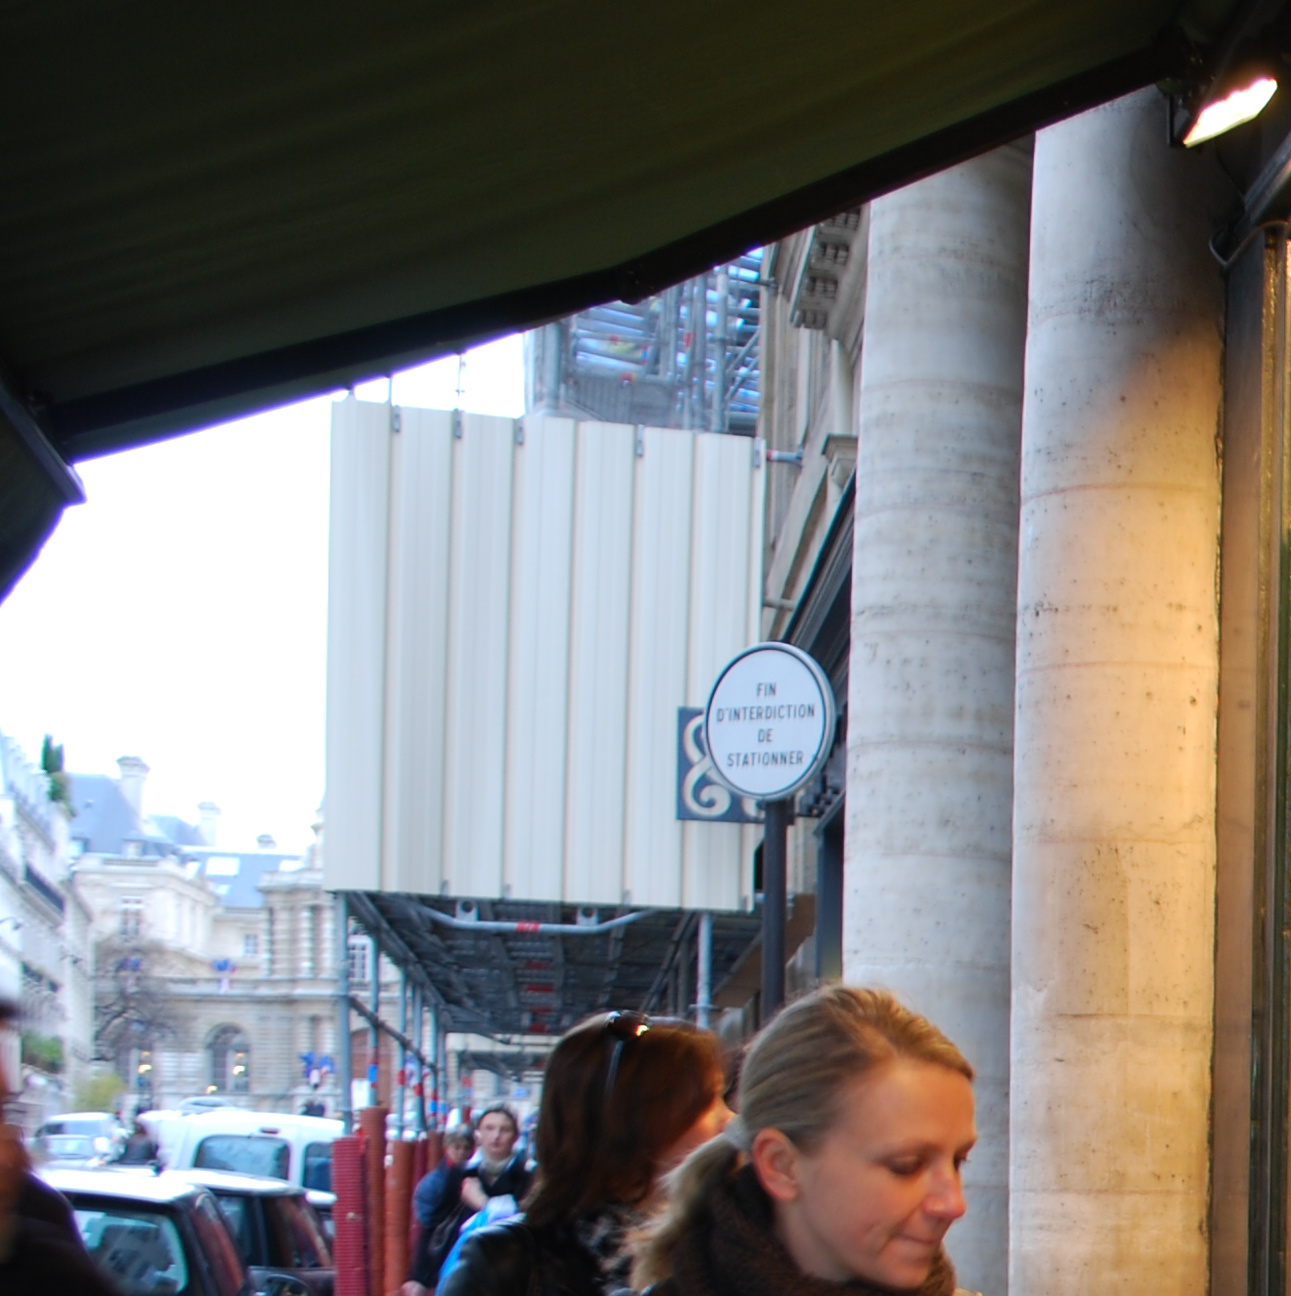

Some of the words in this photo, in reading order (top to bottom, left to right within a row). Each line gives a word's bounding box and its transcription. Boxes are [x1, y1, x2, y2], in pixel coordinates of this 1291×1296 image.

[756, 682, 777, 698] FIN
[716, 703, 816, 723] D'INTERDICTION
[757, 728, 774, 743] DE
[727, 750, 804, 768] STATIONNER
